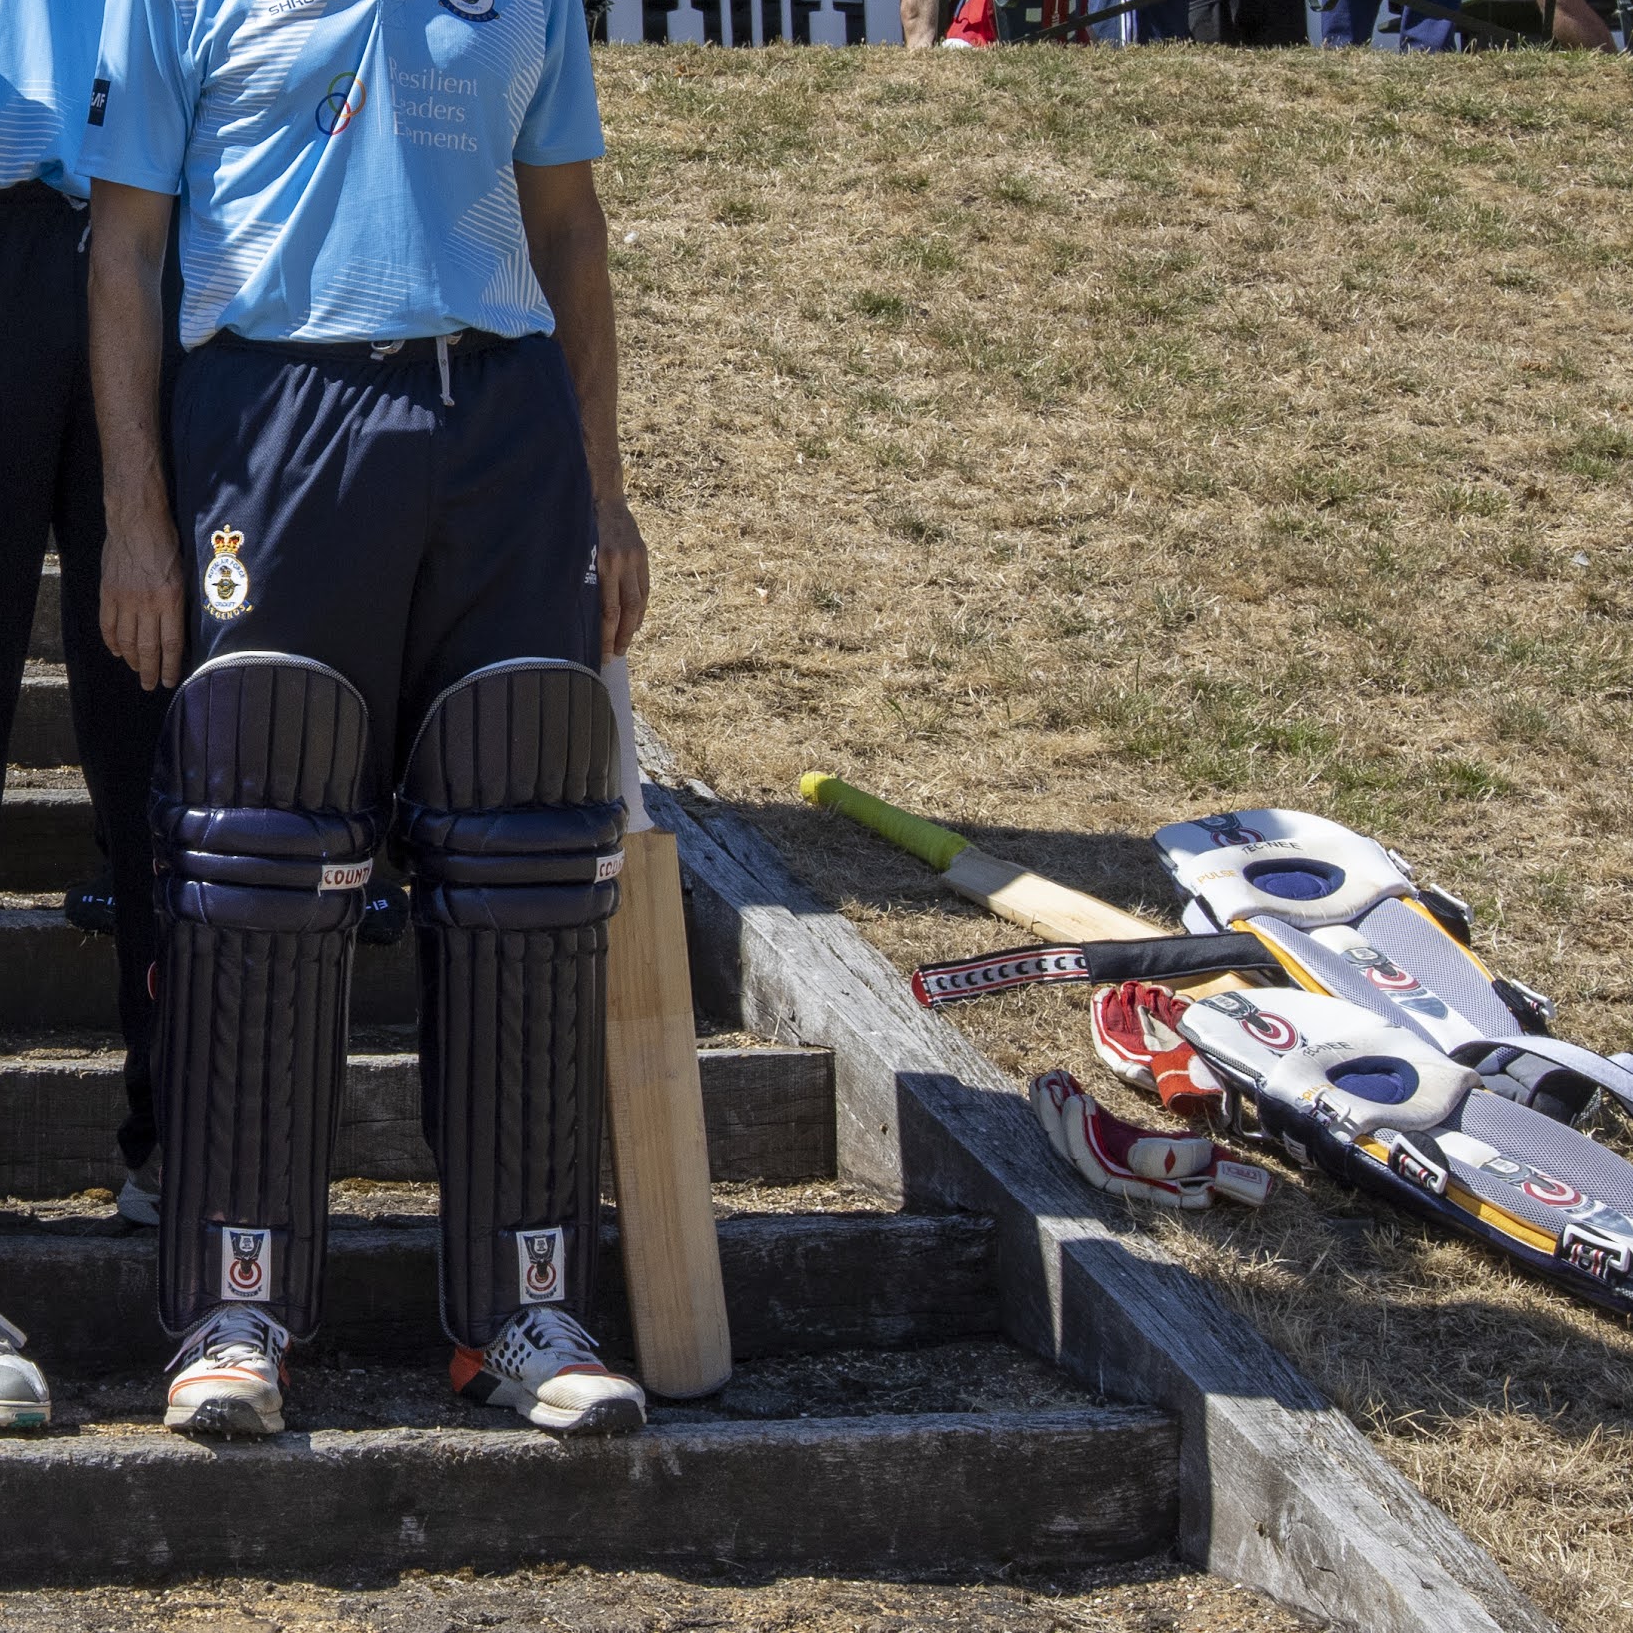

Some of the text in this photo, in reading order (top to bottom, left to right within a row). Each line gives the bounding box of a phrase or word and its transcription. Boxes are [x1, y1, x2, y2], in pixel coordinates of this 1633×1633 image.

[389, 56, 478, 97] Resilient
[1241, 839, 1303, 855] TEC-NEE
[1197, 869, 1239, 884] PULSE
